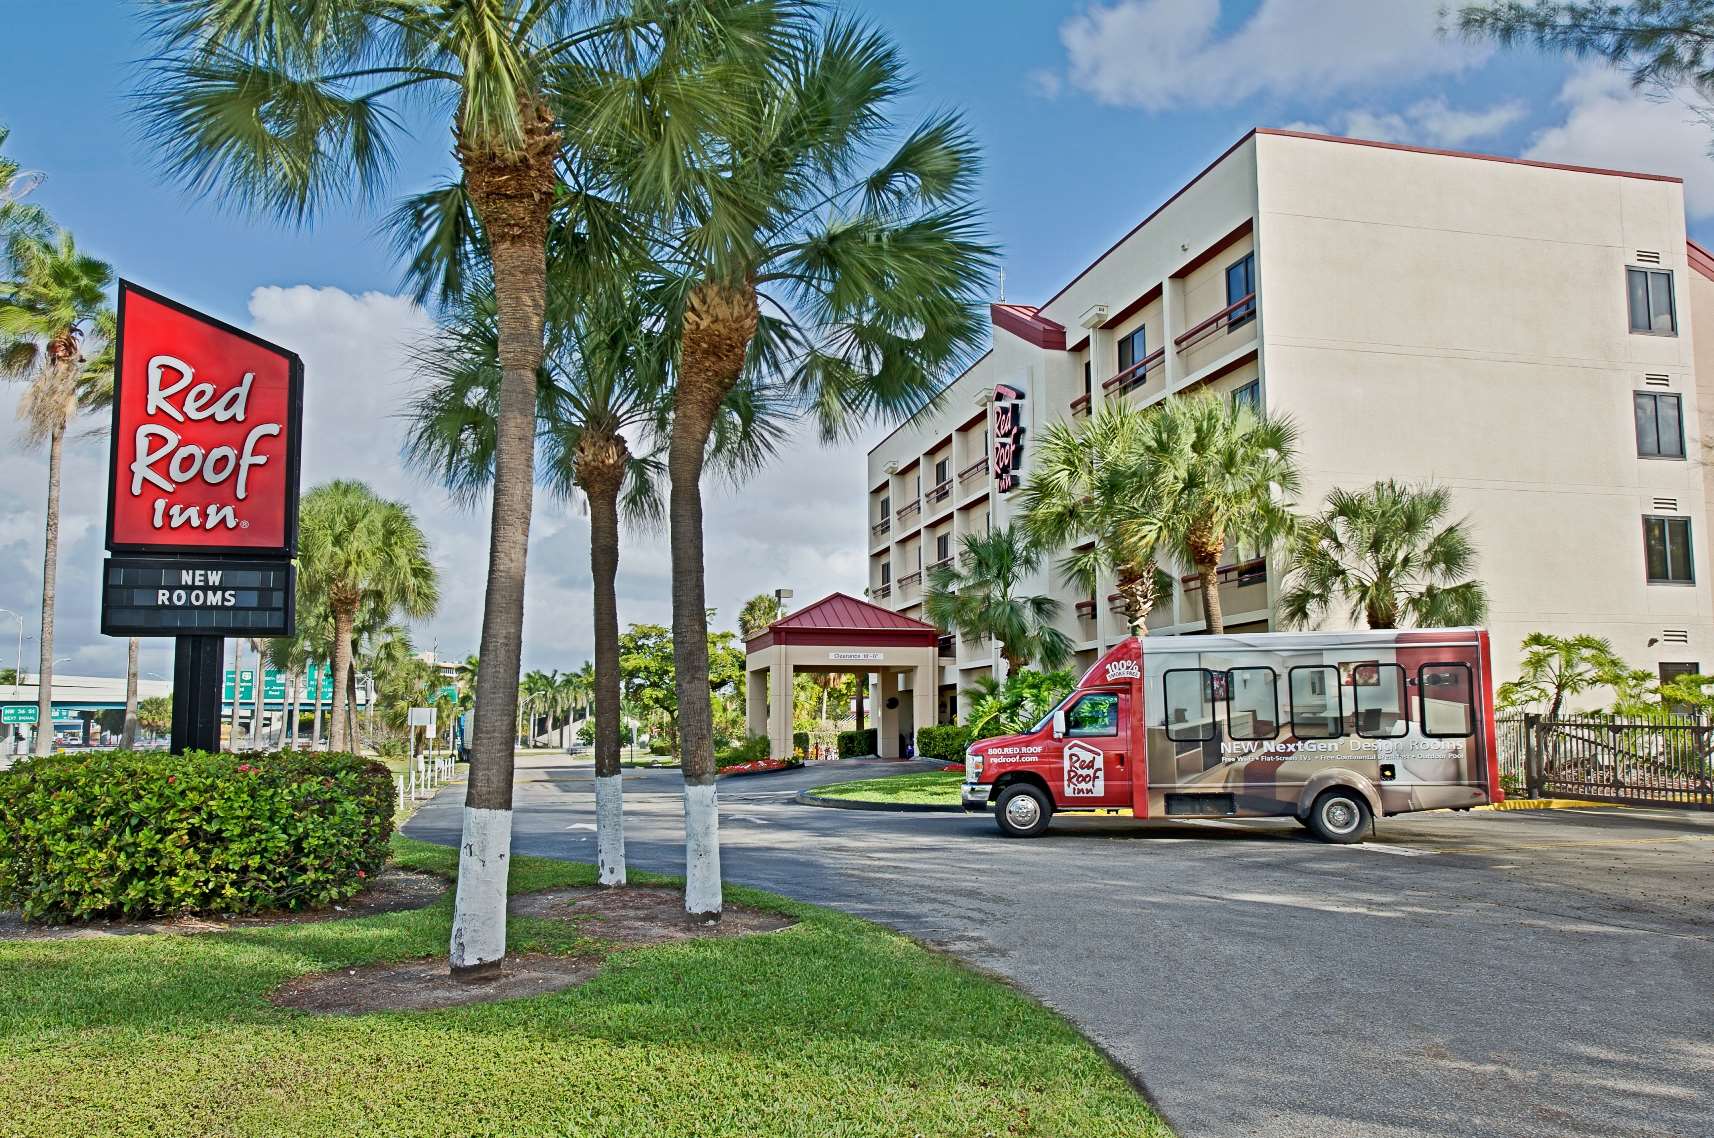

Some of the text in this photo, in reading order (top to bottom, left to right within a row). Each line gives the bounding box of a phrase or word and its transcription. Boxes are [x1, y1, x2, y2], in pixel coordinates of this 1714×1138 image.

[146, 355, 255, 423] Red
[993, 403, 1013, 437] Red
[993, 426, 1018, 475] Roof
[131, 423, 282, 500] Roof
[181, 569, 223, 586] NEW
[157, 590, 236, 606] ROOMS
[1105, 660, 1139, 673] 100%
[987, 746, 1043, 755] 800.RED.ROOF
[1220, 741, 1259, 754] NEW
[1350, 739, 1403, 754] Design
[1410, 739, 1464, 751] Rooms
[989, 755, 1039, 764] redroof.com
[1068, 752, 1096, 771] Red
[1067, 768, 1103, 788] Roof
